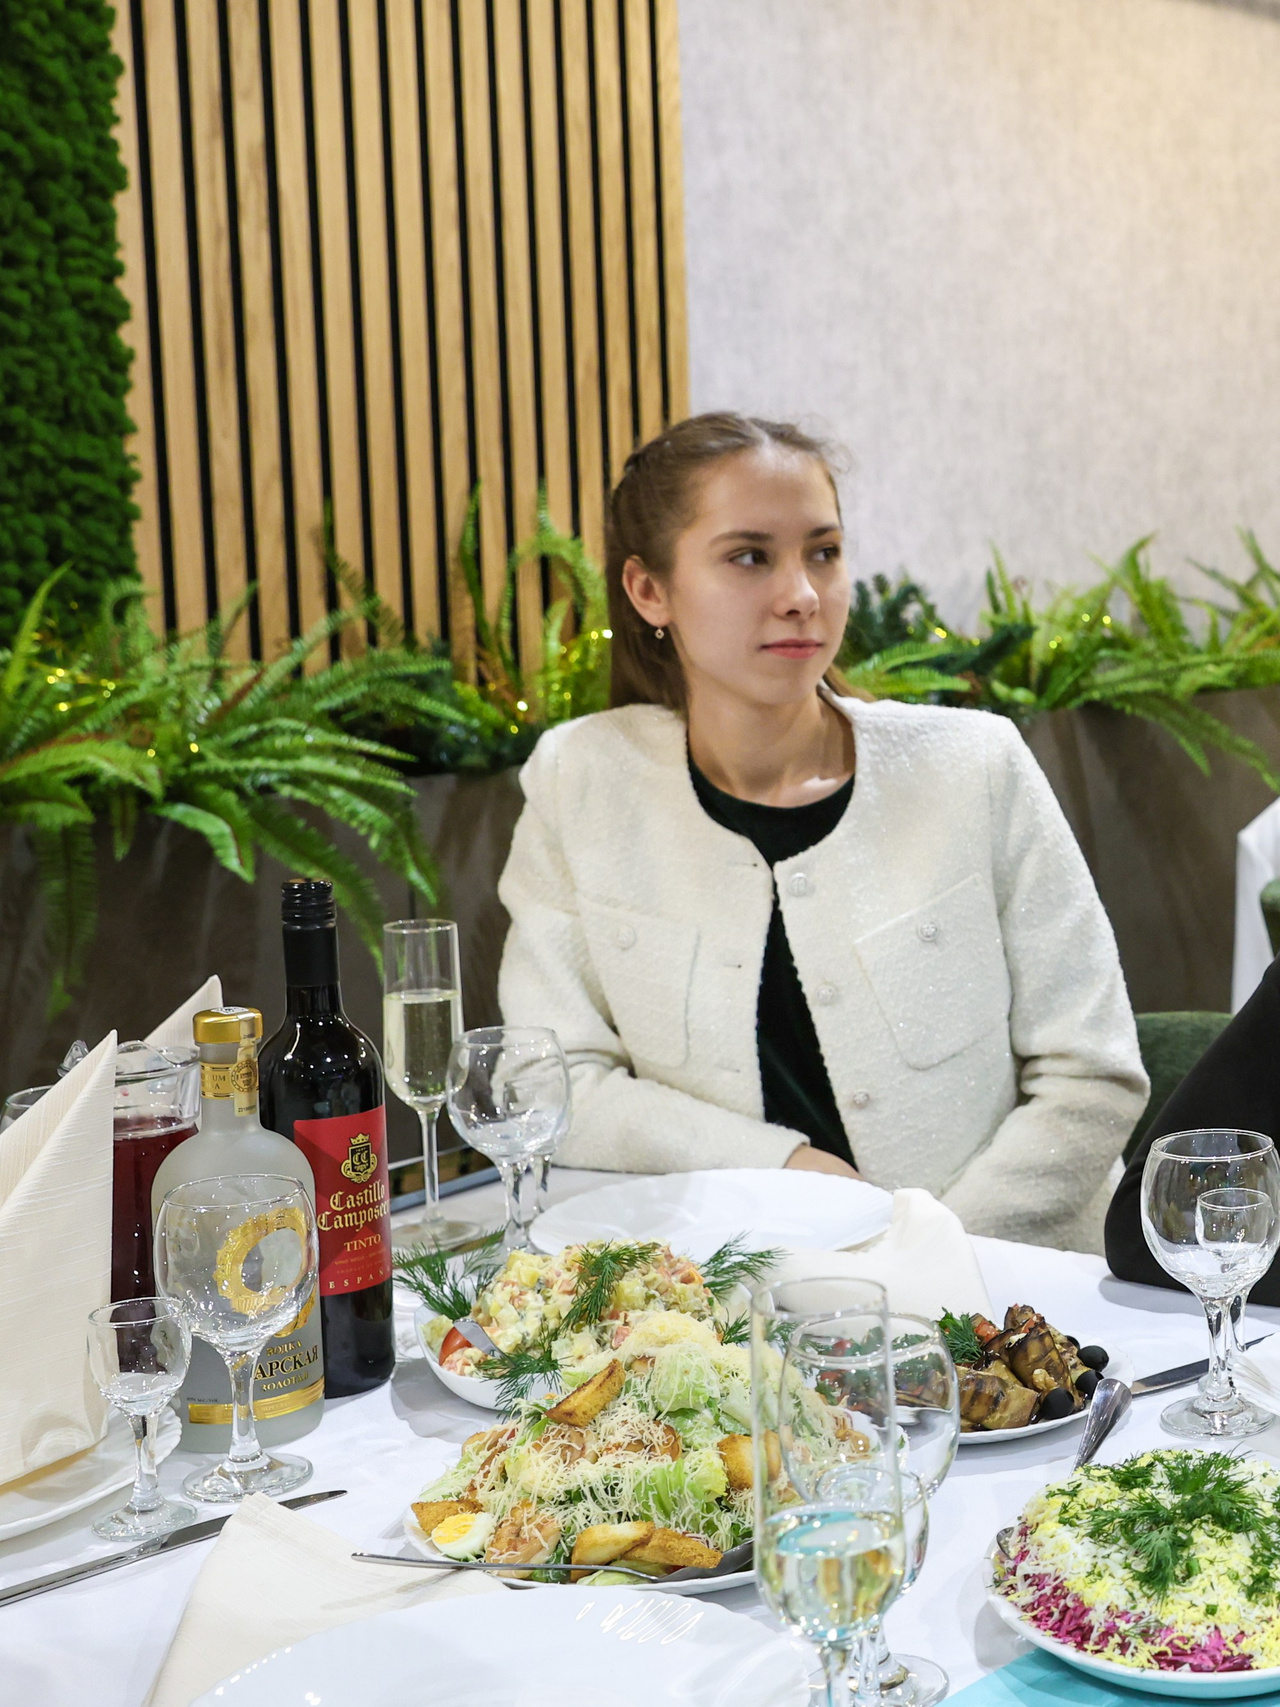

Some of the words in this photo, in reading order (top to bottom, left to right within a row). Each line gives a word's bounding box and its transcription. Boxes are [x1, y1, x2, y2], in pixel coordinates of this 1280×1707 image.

[329, 1178, 385, 1212] Castillo
[343, 1233, 381, 1252] TINTO
[266, 1339, 302, 1357] ВОДКА
[253, 1344, 319, 1381] АРСКАЯ
[261, 1371, 309, 1392] ЗОЛОТАЯ
